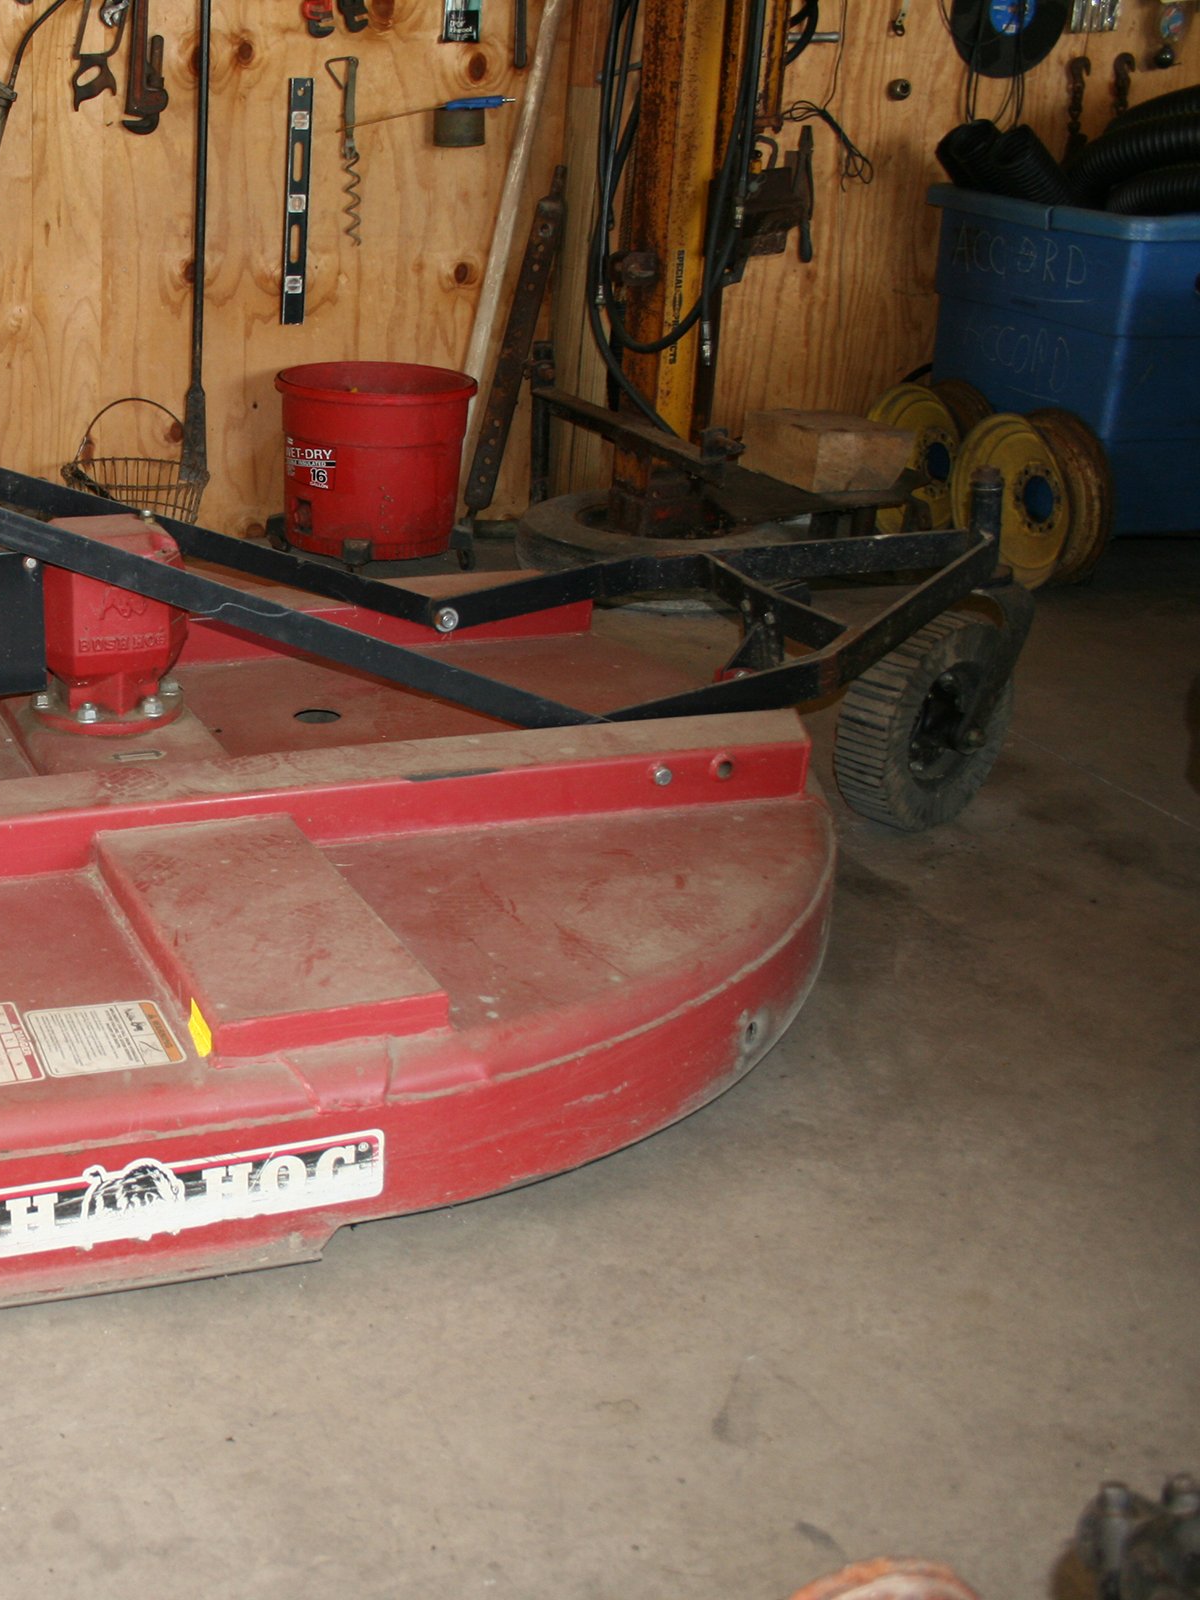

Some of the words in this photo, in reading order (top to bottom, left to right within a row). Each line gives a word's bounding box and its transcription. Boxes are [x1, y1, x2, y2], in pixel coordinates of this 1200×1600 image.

[668, 314, 679, 364] PRCTS
[310, 468, 328, 484] 16
[79, 635, 129, 652] BUSH
